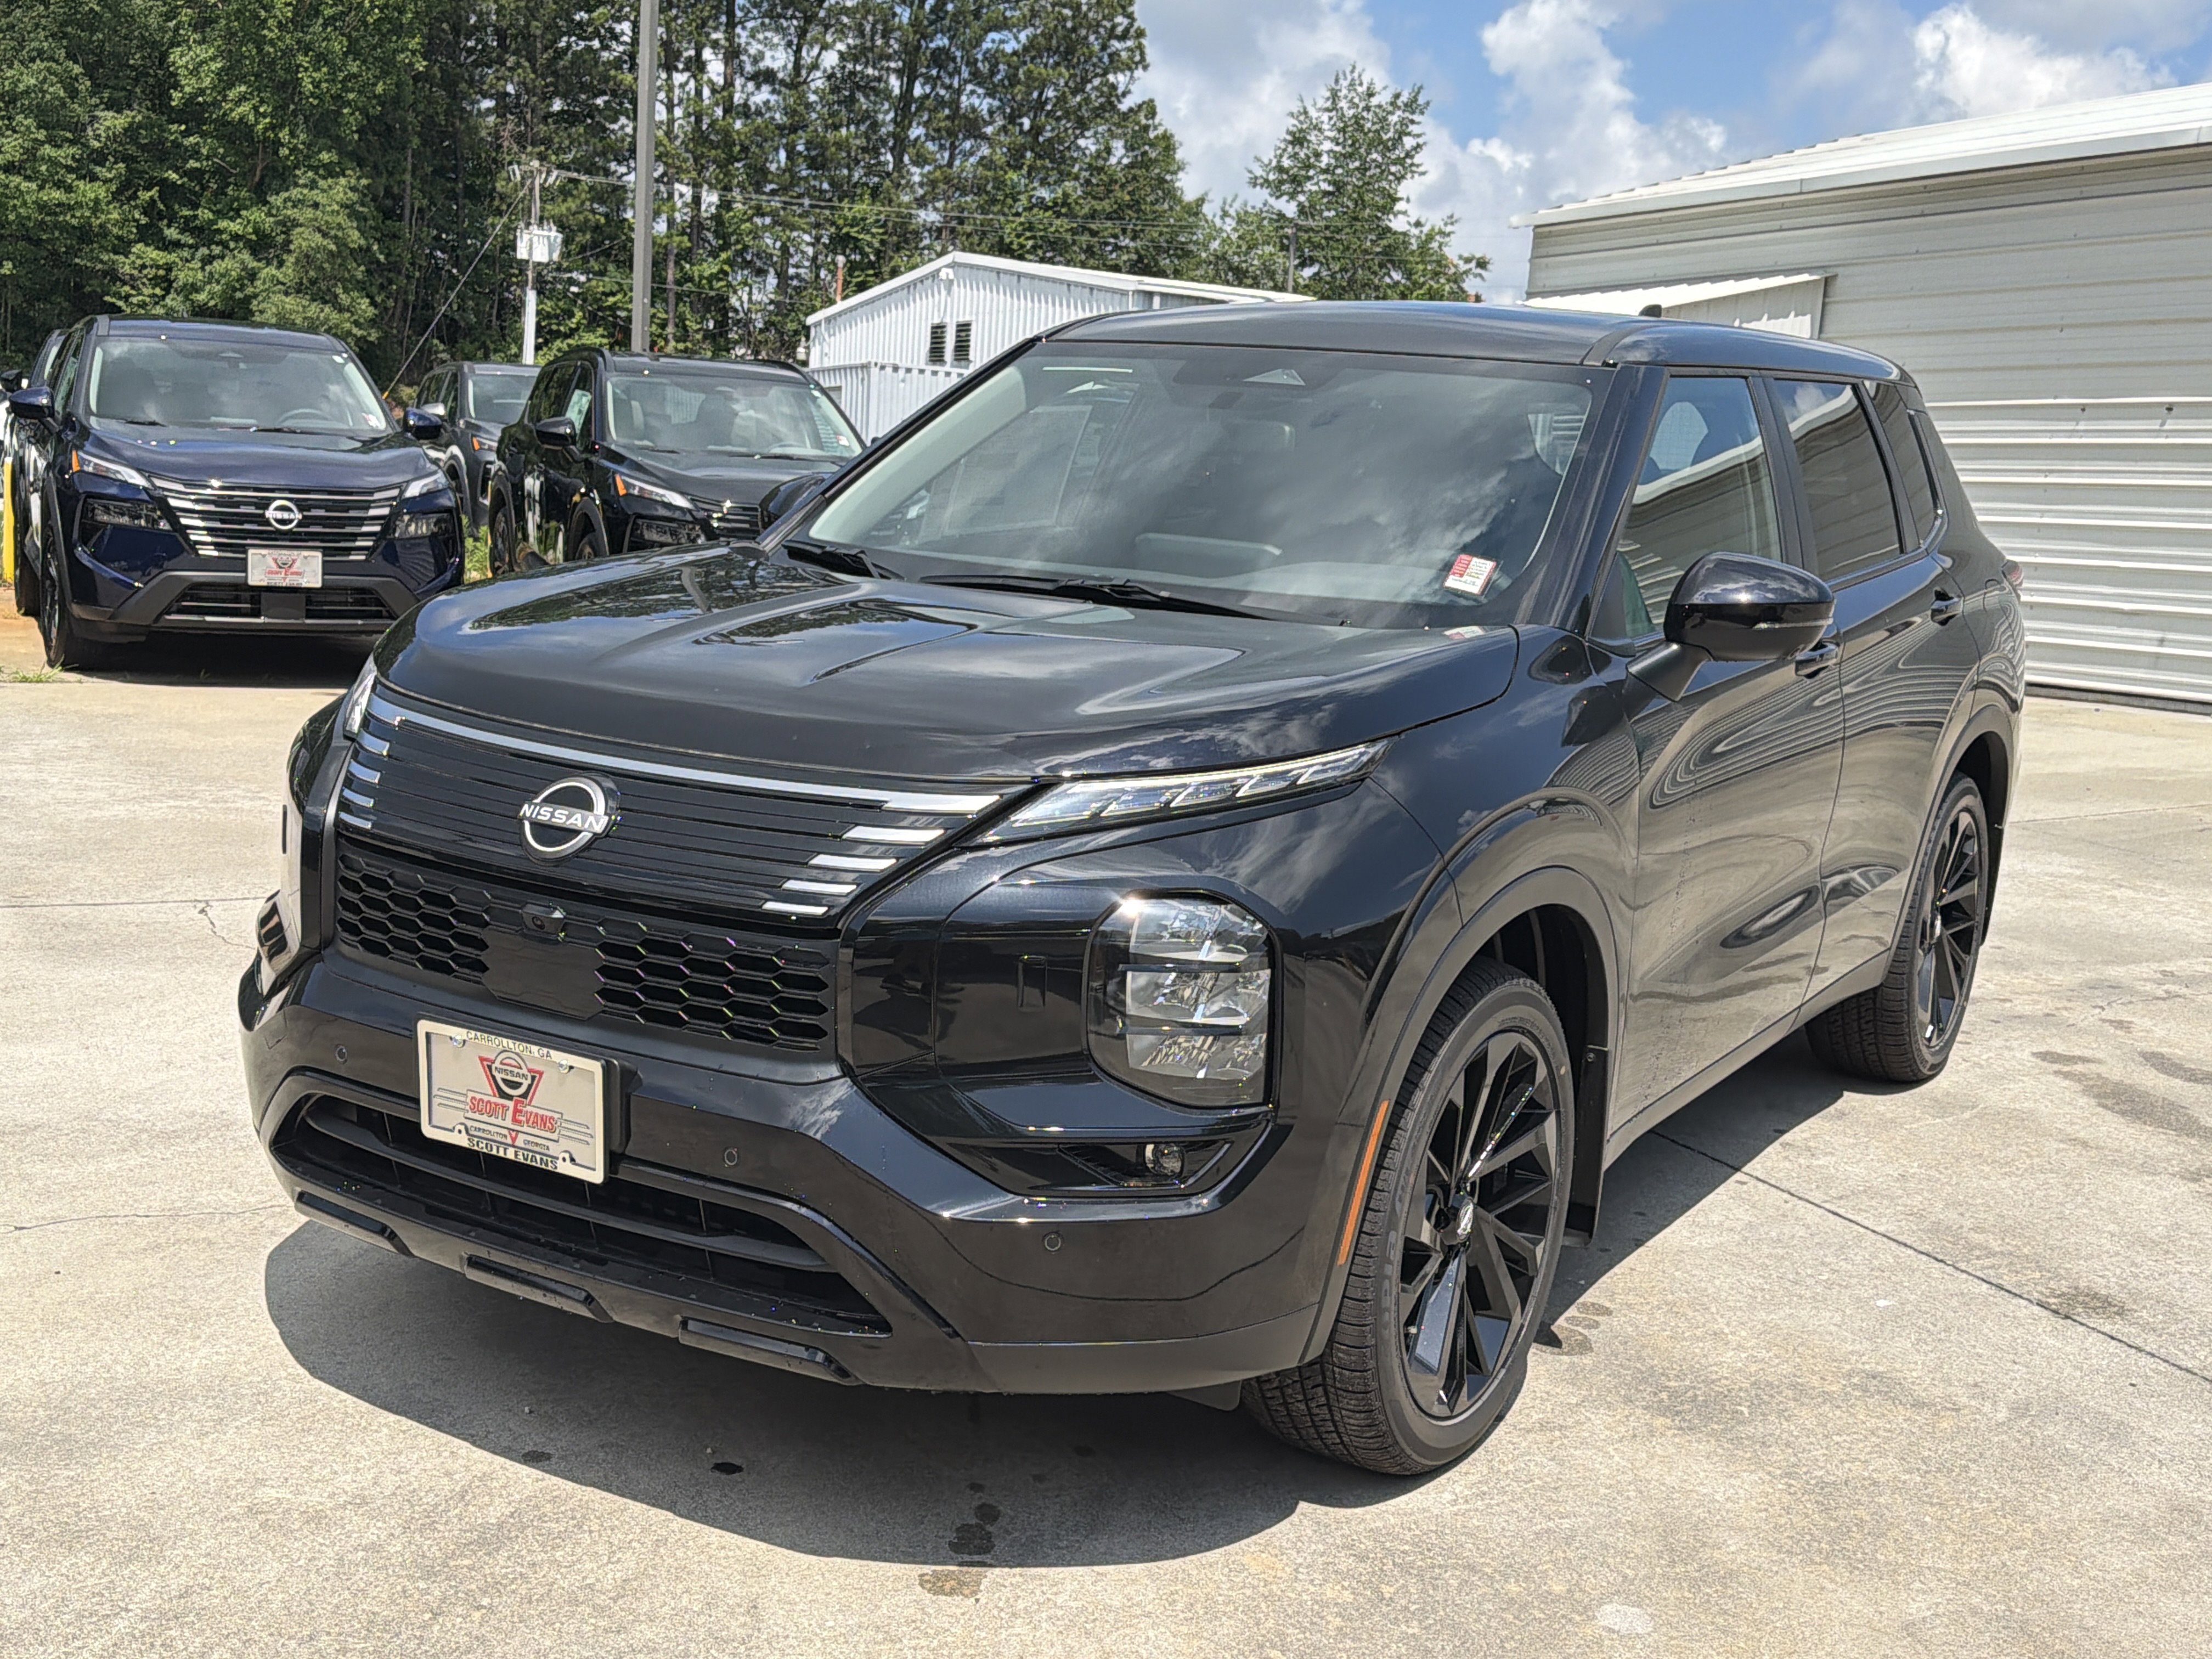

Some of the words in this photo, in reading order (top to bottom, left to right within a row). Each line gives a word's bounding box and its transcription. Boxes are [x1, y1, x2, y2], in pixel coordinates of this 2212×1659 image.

[519, 803, 605, 831] NISSAN
[538, 1047, 552, 1060] GA
[494, 1066, 528, 1080] NISSAN
[469, 1096, 509, 1121] SCOTT
[511, 1097, 556, 1133] EVANS
[467, 1137, 510, 1156] SCOTT
[514, 1149, 558, 1170] EVANS
[523, 1139, 550, 1152] GEORGIA
